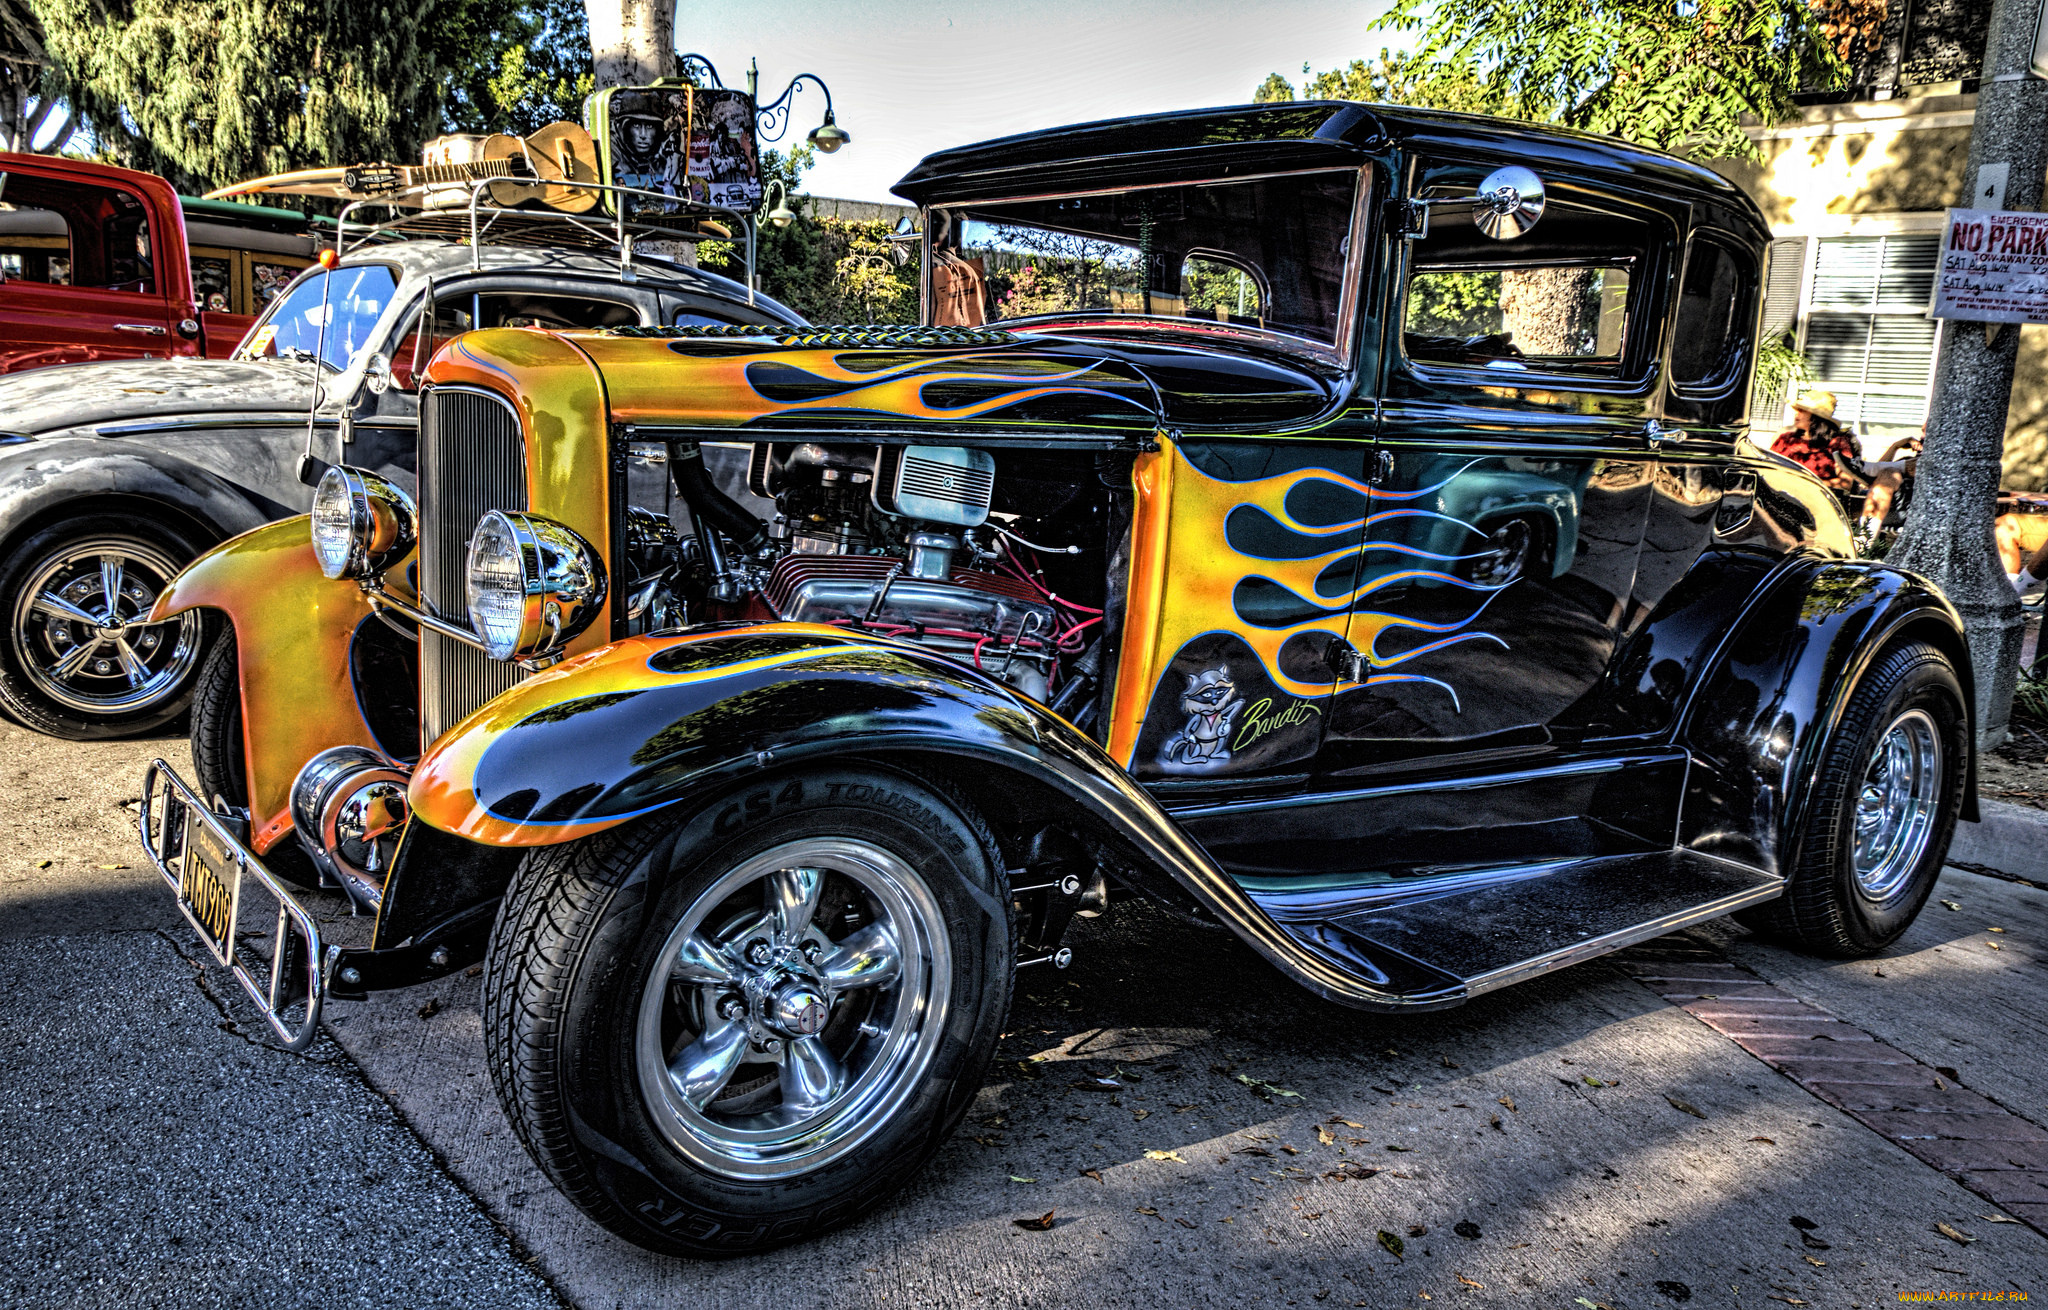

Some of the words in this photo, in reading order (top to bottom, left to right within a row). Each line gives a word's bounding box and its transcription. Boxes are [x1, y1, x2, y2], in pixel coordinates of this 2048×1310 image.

[1984, 184, 1994, 198] 4
[1950, 222, 1983, 252] NO
[1987, 225, 2048, 256] PARK
[1945, 255, 1966, 269] SAT
[1974, 253, 2028, 263] TOW-AWAY
[1943, 275, 1961, 288] SAT
[1232, 697, 1322, 751] Bandit
[712, 779, 805, 834] CS4
[825, 781, 969, 856] TOURING
